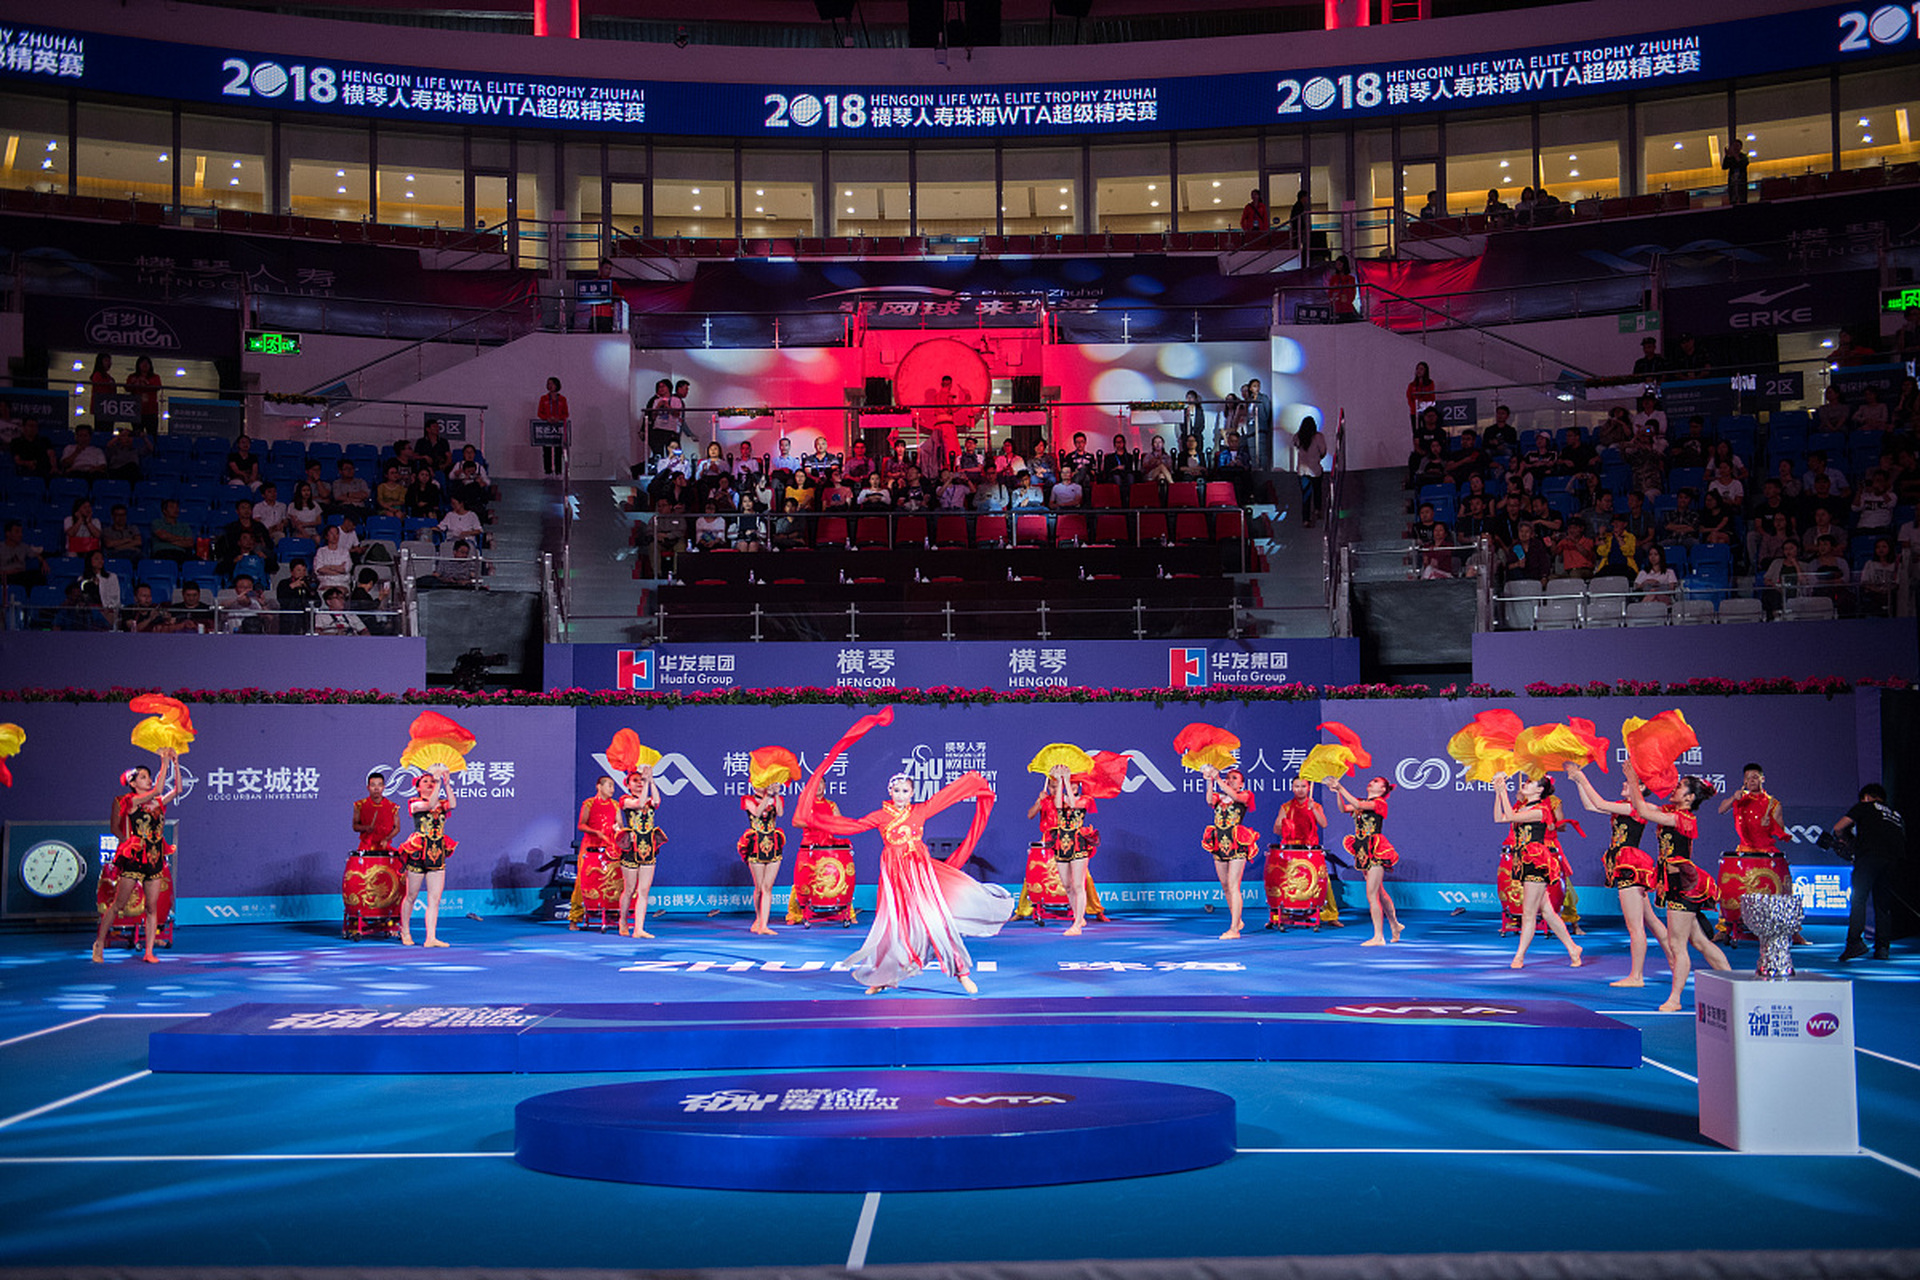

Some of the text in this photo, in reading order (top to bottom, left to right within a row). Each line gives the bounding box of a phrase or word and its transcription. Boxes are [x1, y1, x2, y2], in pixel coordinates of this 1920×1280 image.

[19, 35, 84, 53] ZHUHAI
[1387, 36, 1700, 84] HENGQIN LIFE WTA ELITE TROPHY ZHUHAI
[222, 58, 338, 103] 2018
[341, 69, 644, 102] HENGQIN LIFE WTA ELITE TROPHY ZHUHAI
[871, 88, 1157, 107] HENGQIN LIFE WTA ELITE TROPHY ZHUHAI
[1276, 72, 1383, 114] 2018
[764, 93, 867, 129] 2018
[1728, 307, 1813, 330] ERKE
[1765, 377, 1795, 397] 2区
[100, 400, 137, 418] 16区
[1442, 404, 1469, 421] 2区
[659, 655, 735, 672] 华发集团
[836, 648, 897, 674] 横琴
[1008, 647, 1068, 674] 横琴
[1211, 652, 1288, 670] 华发集团
[660, 673, 733, 688] Huafa Group
[836, 678, 896, 689] HENGQIN
[1008, 676, 1069, 688] HENGQIN
[1213, 671, 1287, 686] Huafa Group
[207, 766, 321, 795] 中交城投
[1455, 781, 1515, 792] DA HEG
[233, 793, 262, 801] URBAN
[265, 792, 319, 800] INVESTMENT
[490, 787, 515, 799] QIN
[1121, 891, 1156, 902] ELITE
[1158, 890, 1209, 901] TROPHY
[1334, 1005, 1518, 1014] WTA
[1748, 1012, 1770, 1025] ZHU
[1808, 1019, 1838, 1035] WTA
[1750, 1024, 1769, 1037] HAI
[945, 1095, 1067, 1106] WTA
